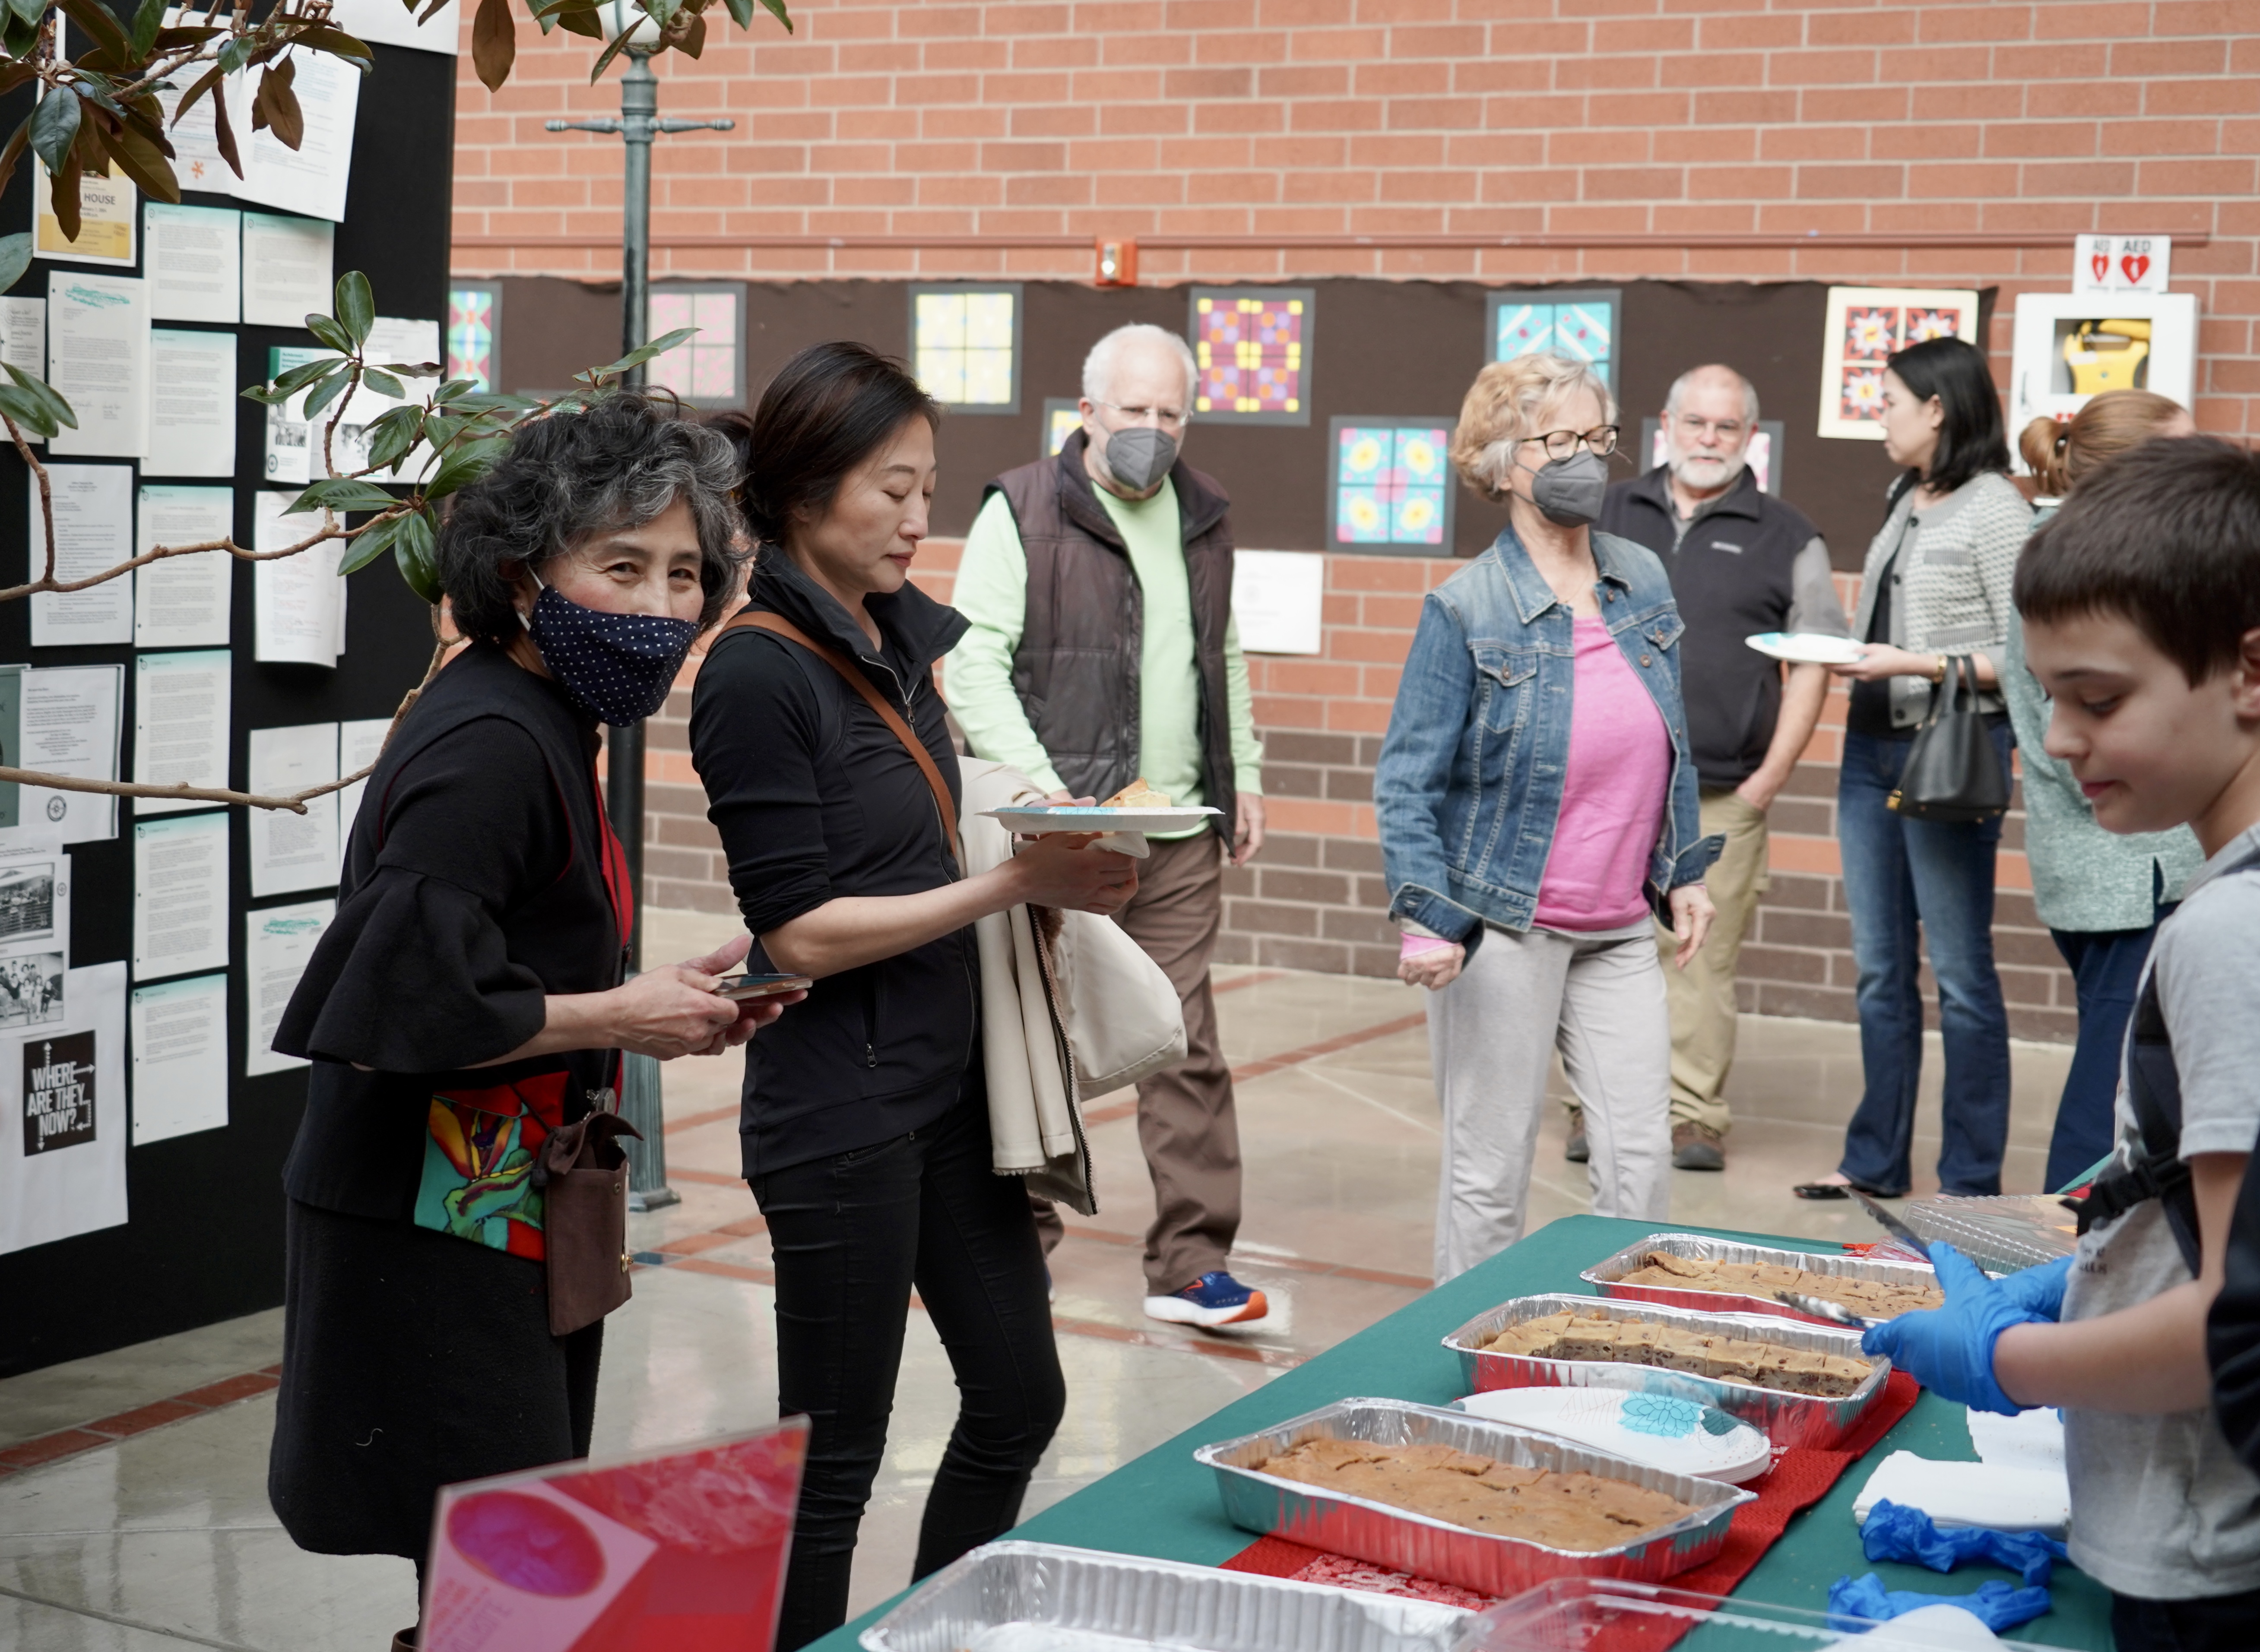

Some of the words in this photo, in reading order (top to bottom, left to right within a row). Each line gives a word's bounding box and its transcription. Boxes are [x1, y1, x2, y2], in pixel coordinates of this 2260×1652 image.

[84, 193, 116, 205] HOUSE
[2122, 240, 2151, 252] AED
[32, 1061, 77, 1092] WHERE
[27, 1089, 53, 1117] ARE
[54, 1082, 86, 1111] THEY
[39, 1107, 77, 1136] NOW?
